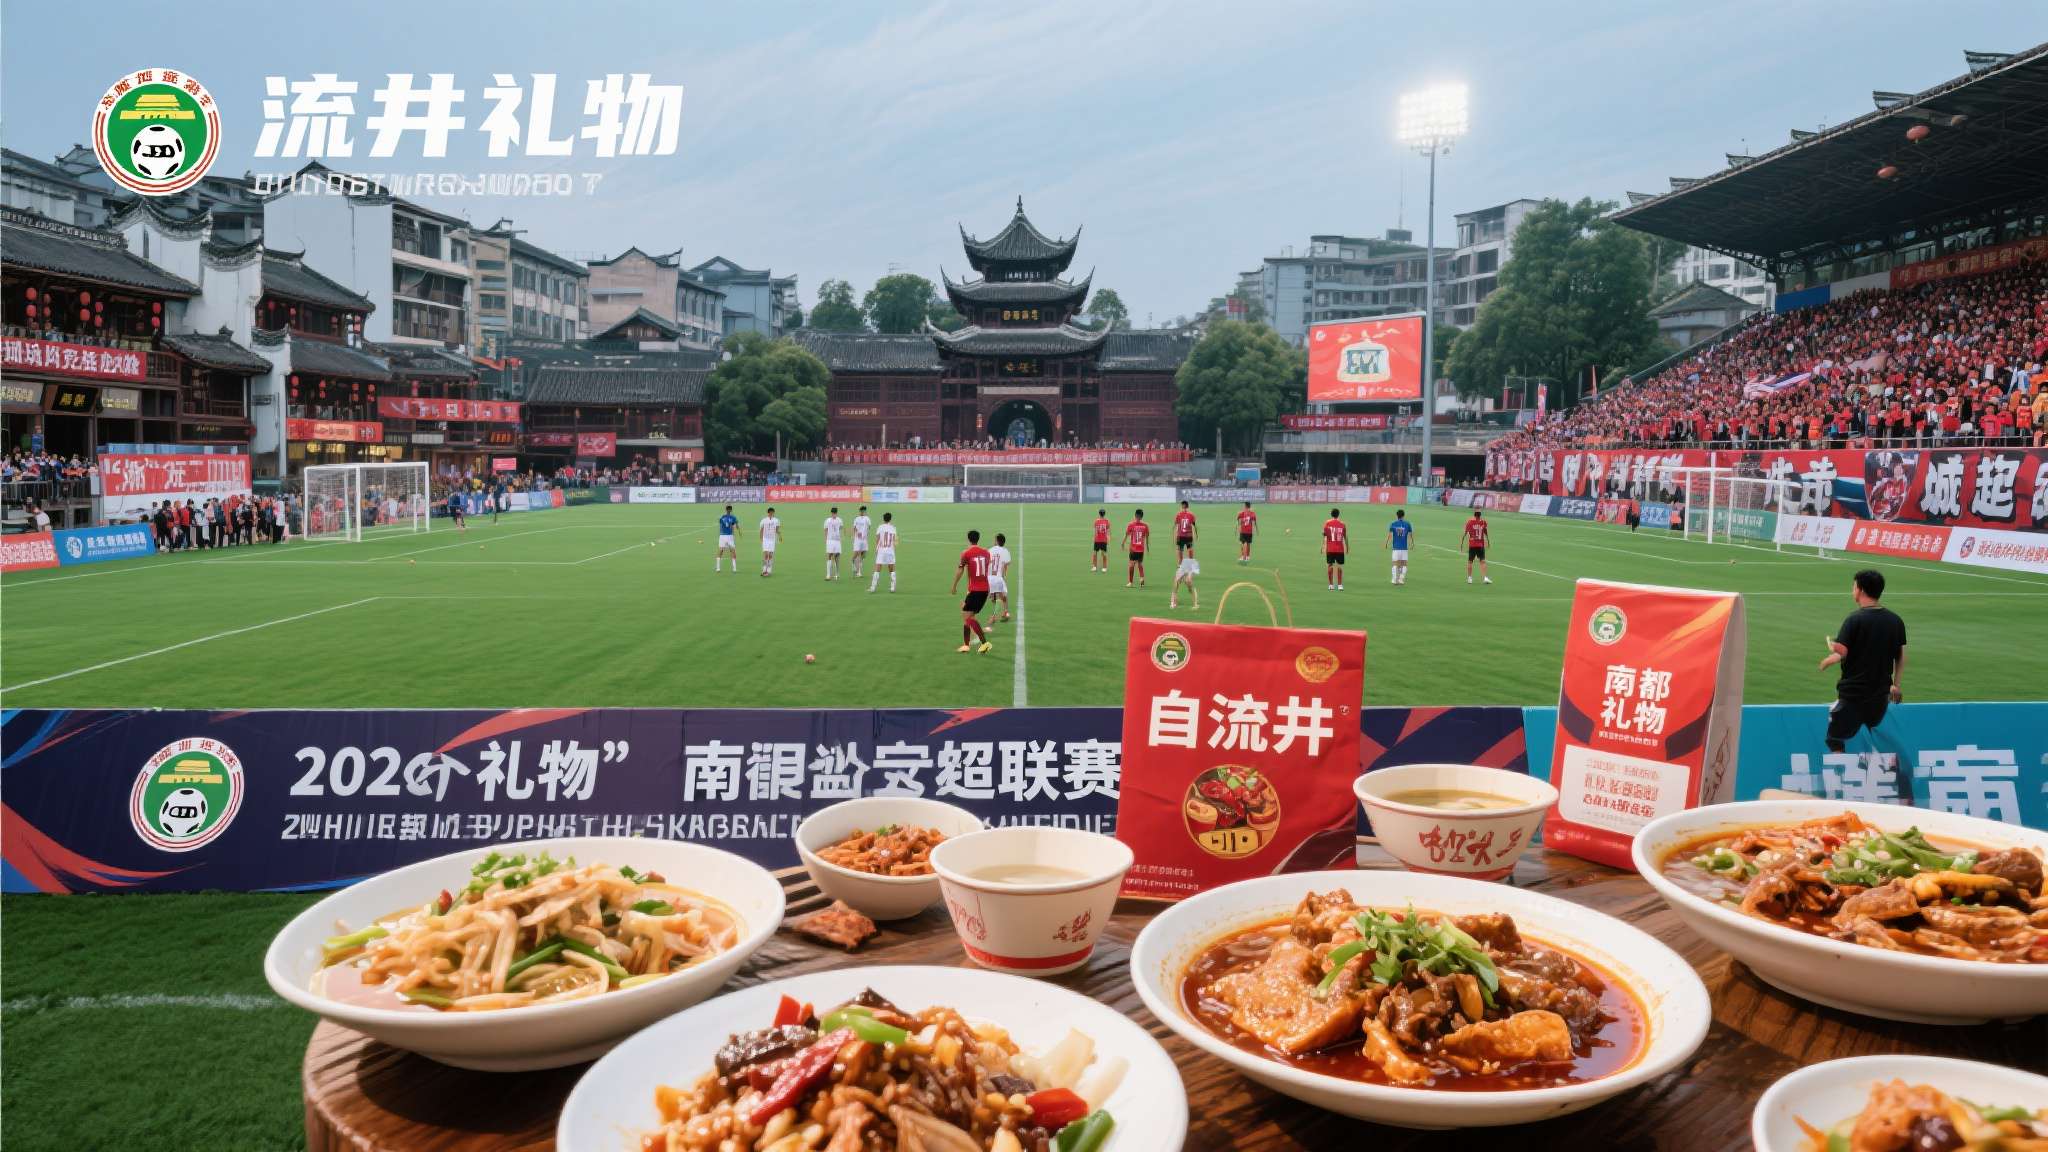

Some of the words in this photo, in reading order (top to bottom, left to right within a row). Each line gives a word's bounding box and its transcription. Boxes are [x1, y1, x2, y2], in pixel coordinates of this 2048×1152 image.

[974, 557, 986, 577] 11
[1604, 665, 1672, 702] 南都
[1148, 689, 1334, 757] 自流井
[1600, 697, 1667, 734] 礼物
